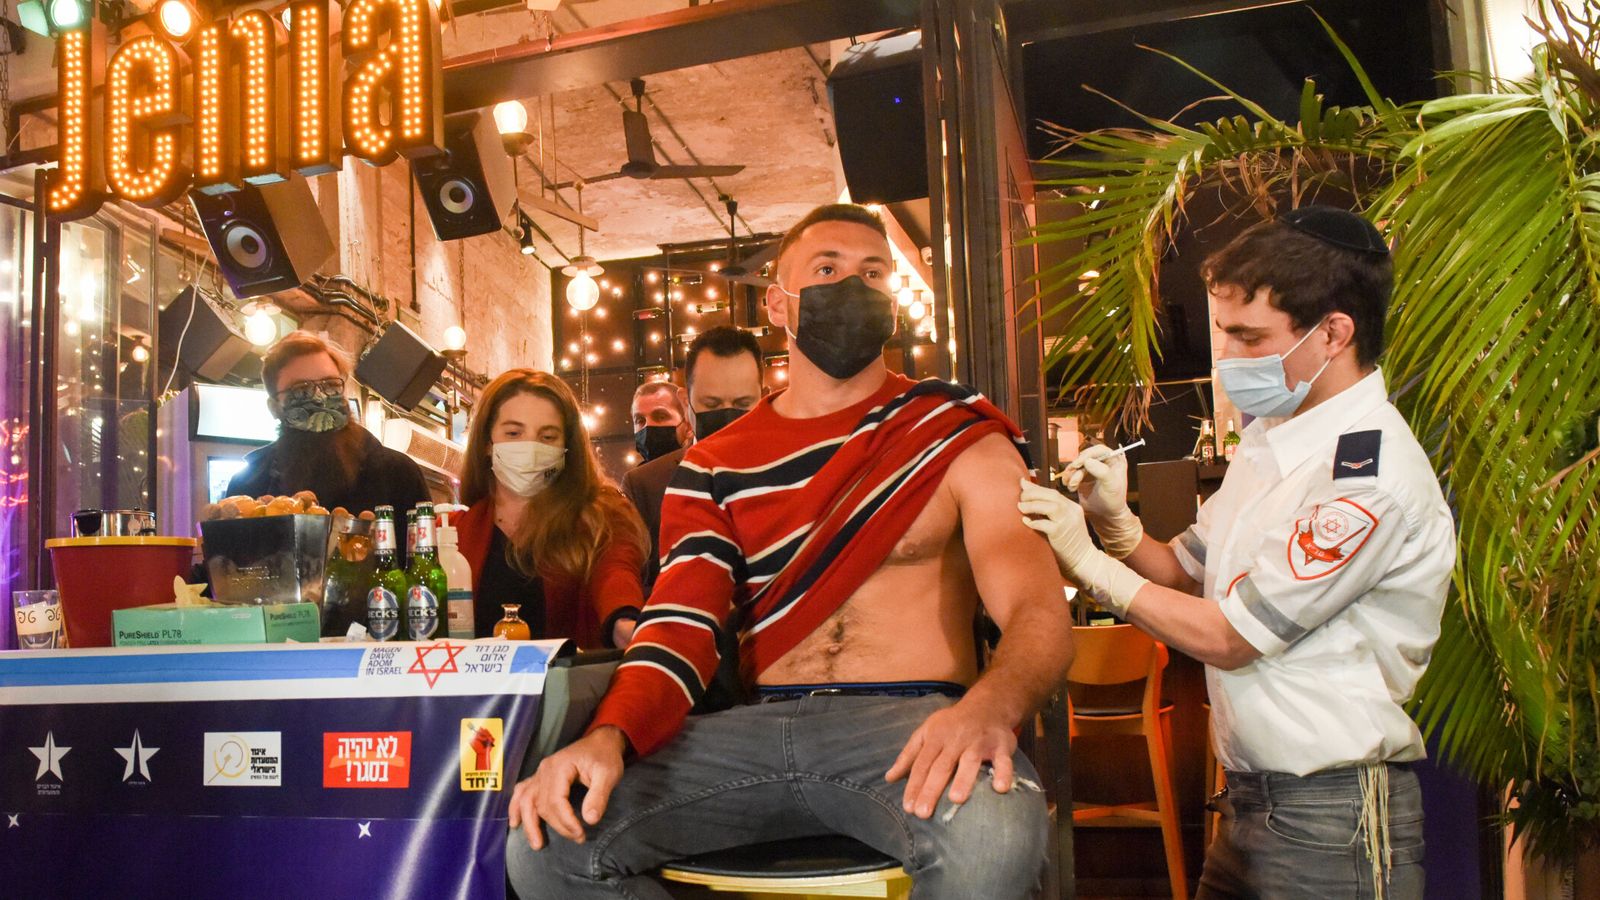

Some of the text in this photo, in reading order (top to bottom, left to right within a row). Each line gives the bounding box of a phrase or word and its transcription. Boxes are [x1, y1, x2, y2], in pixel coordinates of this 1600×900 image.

[162, 629, 182, 638] PL78
[474, 645, 510, 653] מגן דוד
[480, 653, 507, 662] אדום
[365, 667, 402, 676] IN ISRAEL
[464, 662, 503, 673] בישראל
[338, 735, 398, 759] לא יהיה
[250, 764, 276, 774] הישראלי
[346, 760, 389, 782] בסגר!
[465, 777, 498, 789] ביחד
